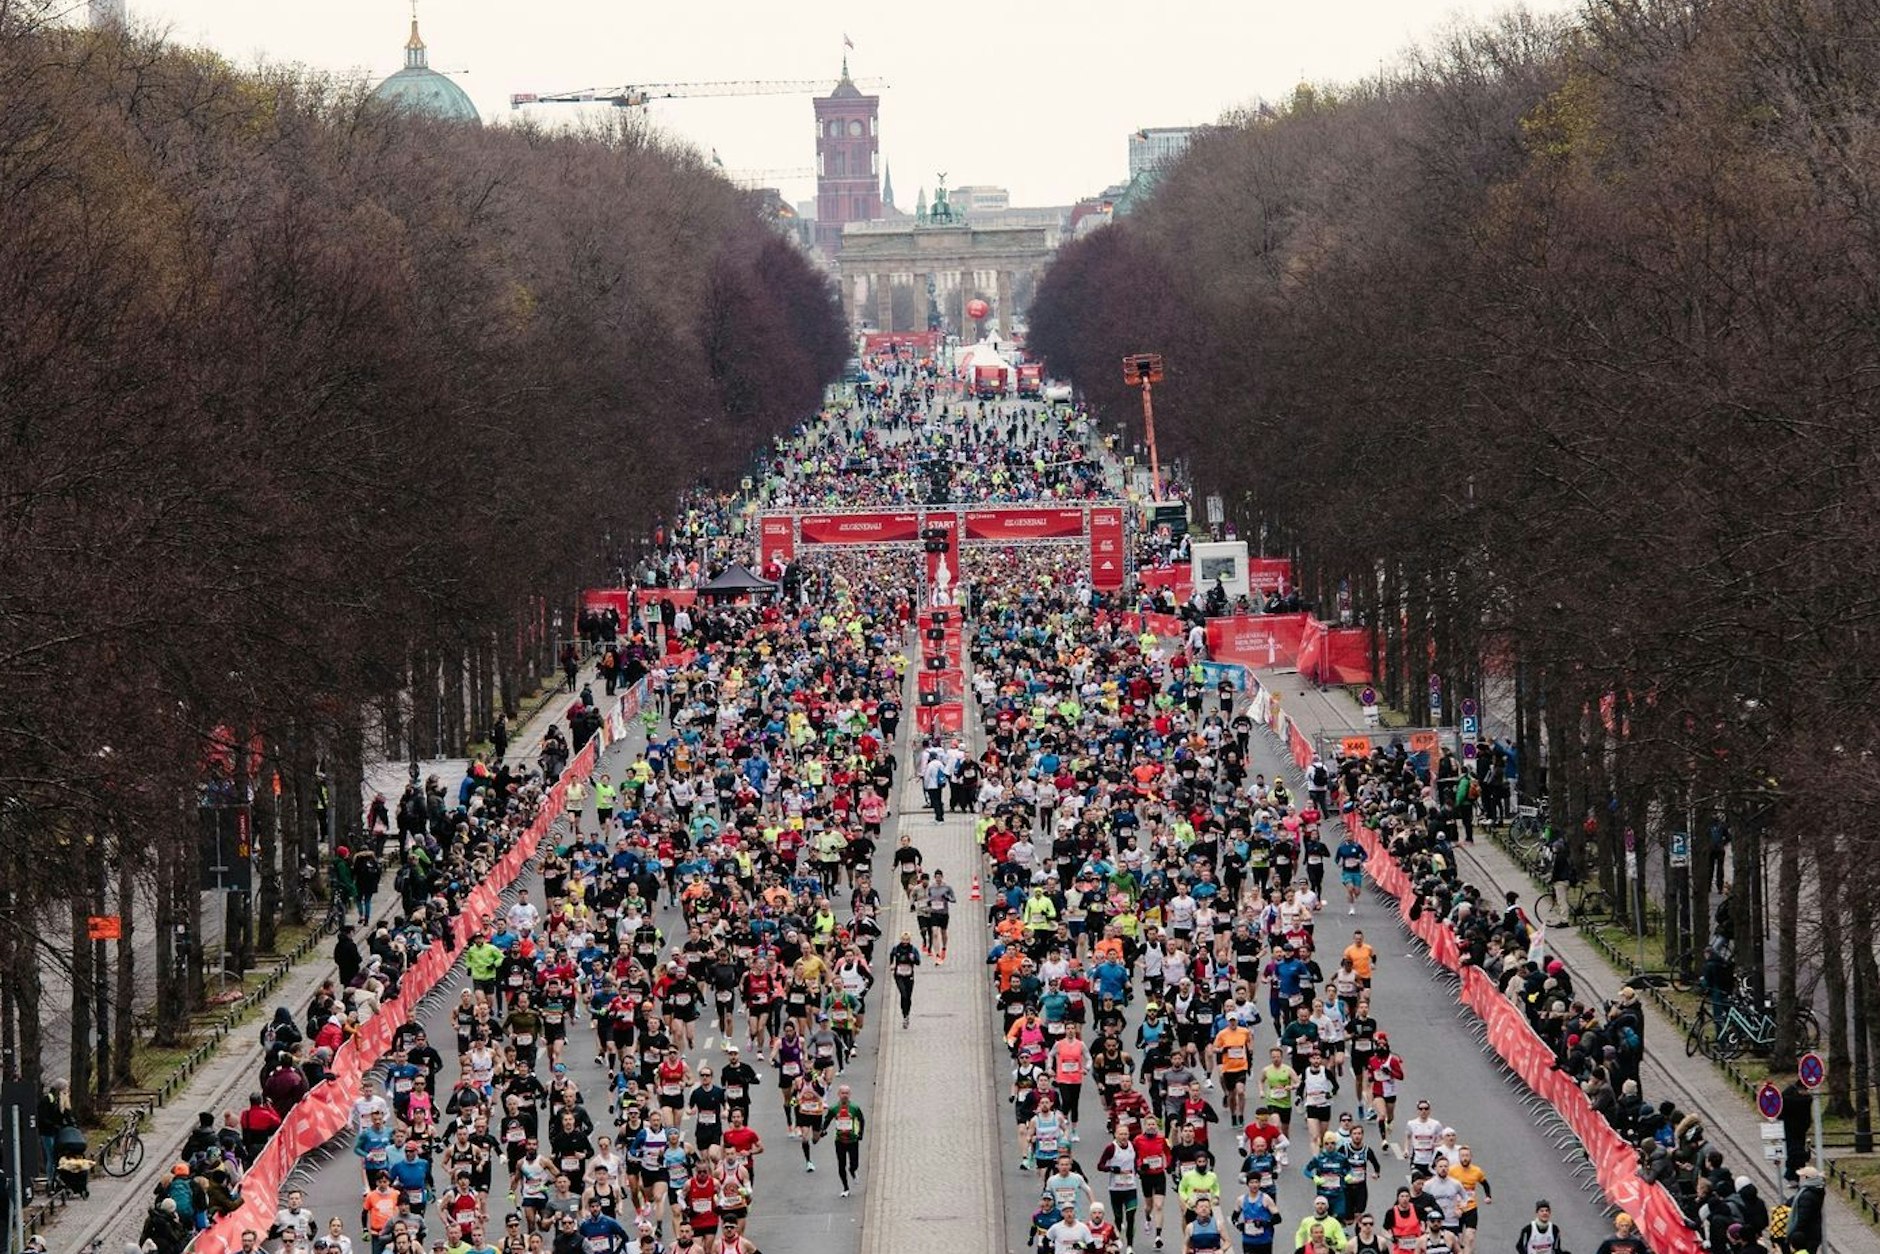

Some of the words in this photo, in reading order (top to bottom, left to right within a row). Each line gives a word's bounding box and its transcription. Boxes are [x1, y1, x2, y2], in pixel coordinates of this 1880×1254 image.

[928, 520, 956, 529] START
[1463, 718, 1472, 732] P
[1347, 741, 1365, 749] K40
[1673, 835, 1683, 852] P
